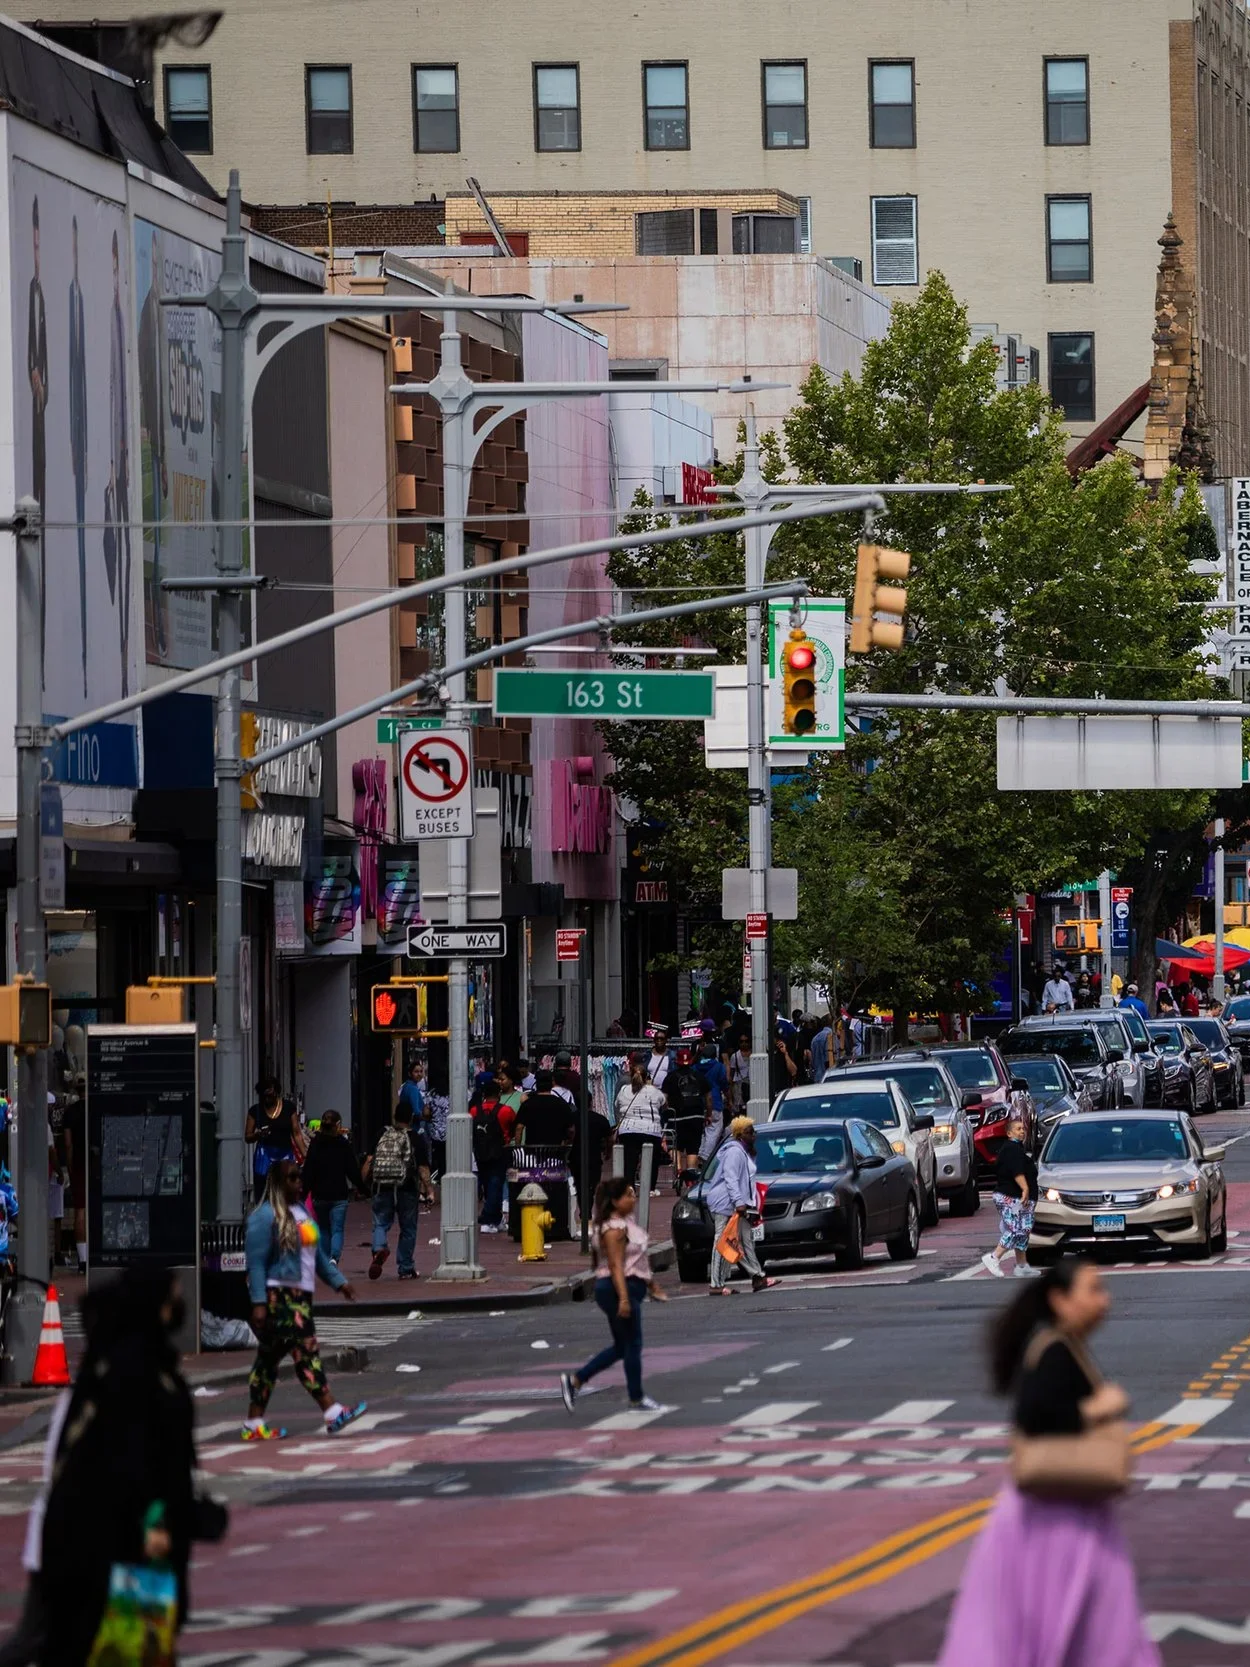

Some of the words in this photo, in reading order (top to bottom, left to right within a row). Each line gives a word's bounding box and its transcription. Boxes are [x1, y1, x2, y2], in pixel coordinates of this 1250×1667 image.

[566, 680, 605, 708] 163
[616, 681, 643, 708] St
[415, 807, 462, 819] EXCEPT
[418, 821, 460, 834] BUSES
[635, 881, 669, 902] ATM
[420, 935, 450, 948] ONE
[465, 934, 497, 947] WAY
[557, 939, 574, 947] Anytime
